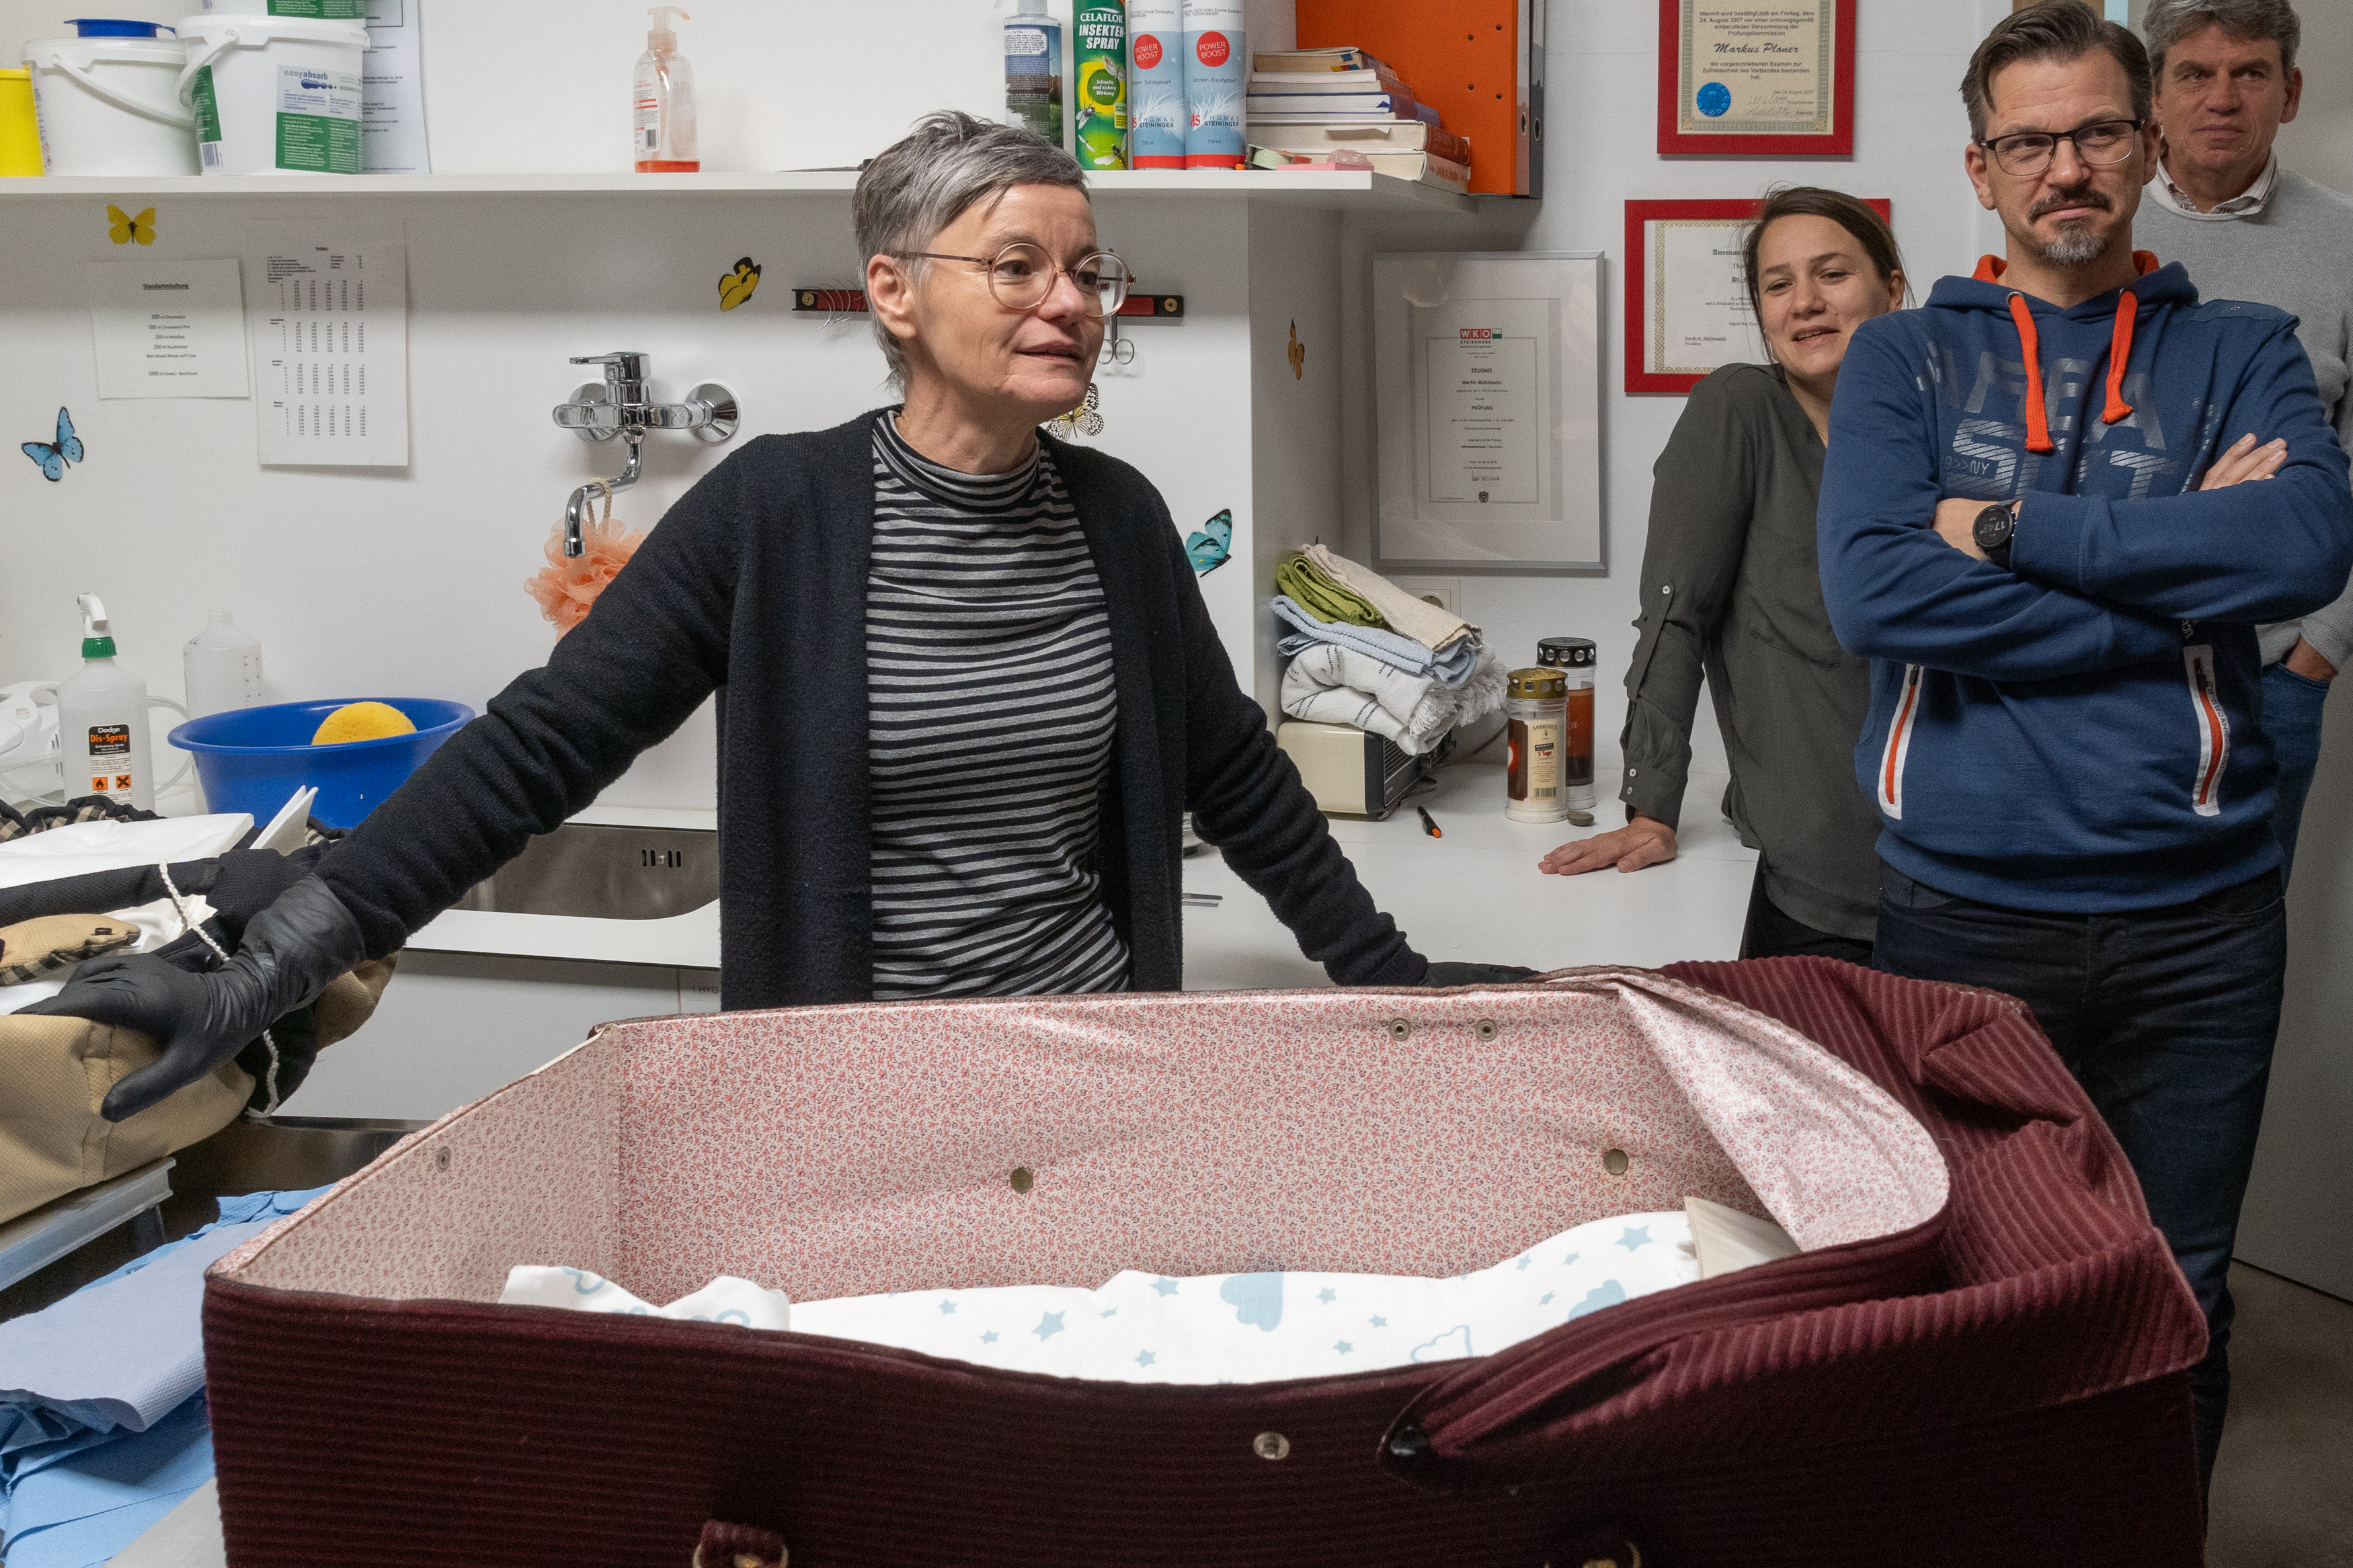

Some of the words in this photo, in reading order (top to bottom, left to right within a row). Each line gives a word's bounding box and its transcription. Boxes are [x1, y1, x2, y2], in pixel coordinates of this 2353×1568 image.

[1080, 13, 1123, 24] CELAFLOR
[1086, 36, 1120, 50] SPRAY
[1135, 43, 1158, 54] POWER
[1199, 41, 1226, 51] POWER
[1714, 42, 1759, 54] Markus
[1763, 42, 1799, 54] Ploner
[1136, 50, 1158, 62] BOOST
[1201, 48, 1226, 59] BOOST
[284, 70, 328, 80] easyabsorb
[1460, 329, 1491, 339] WKO
[90, 733, 128, 744] Dis-Spray
